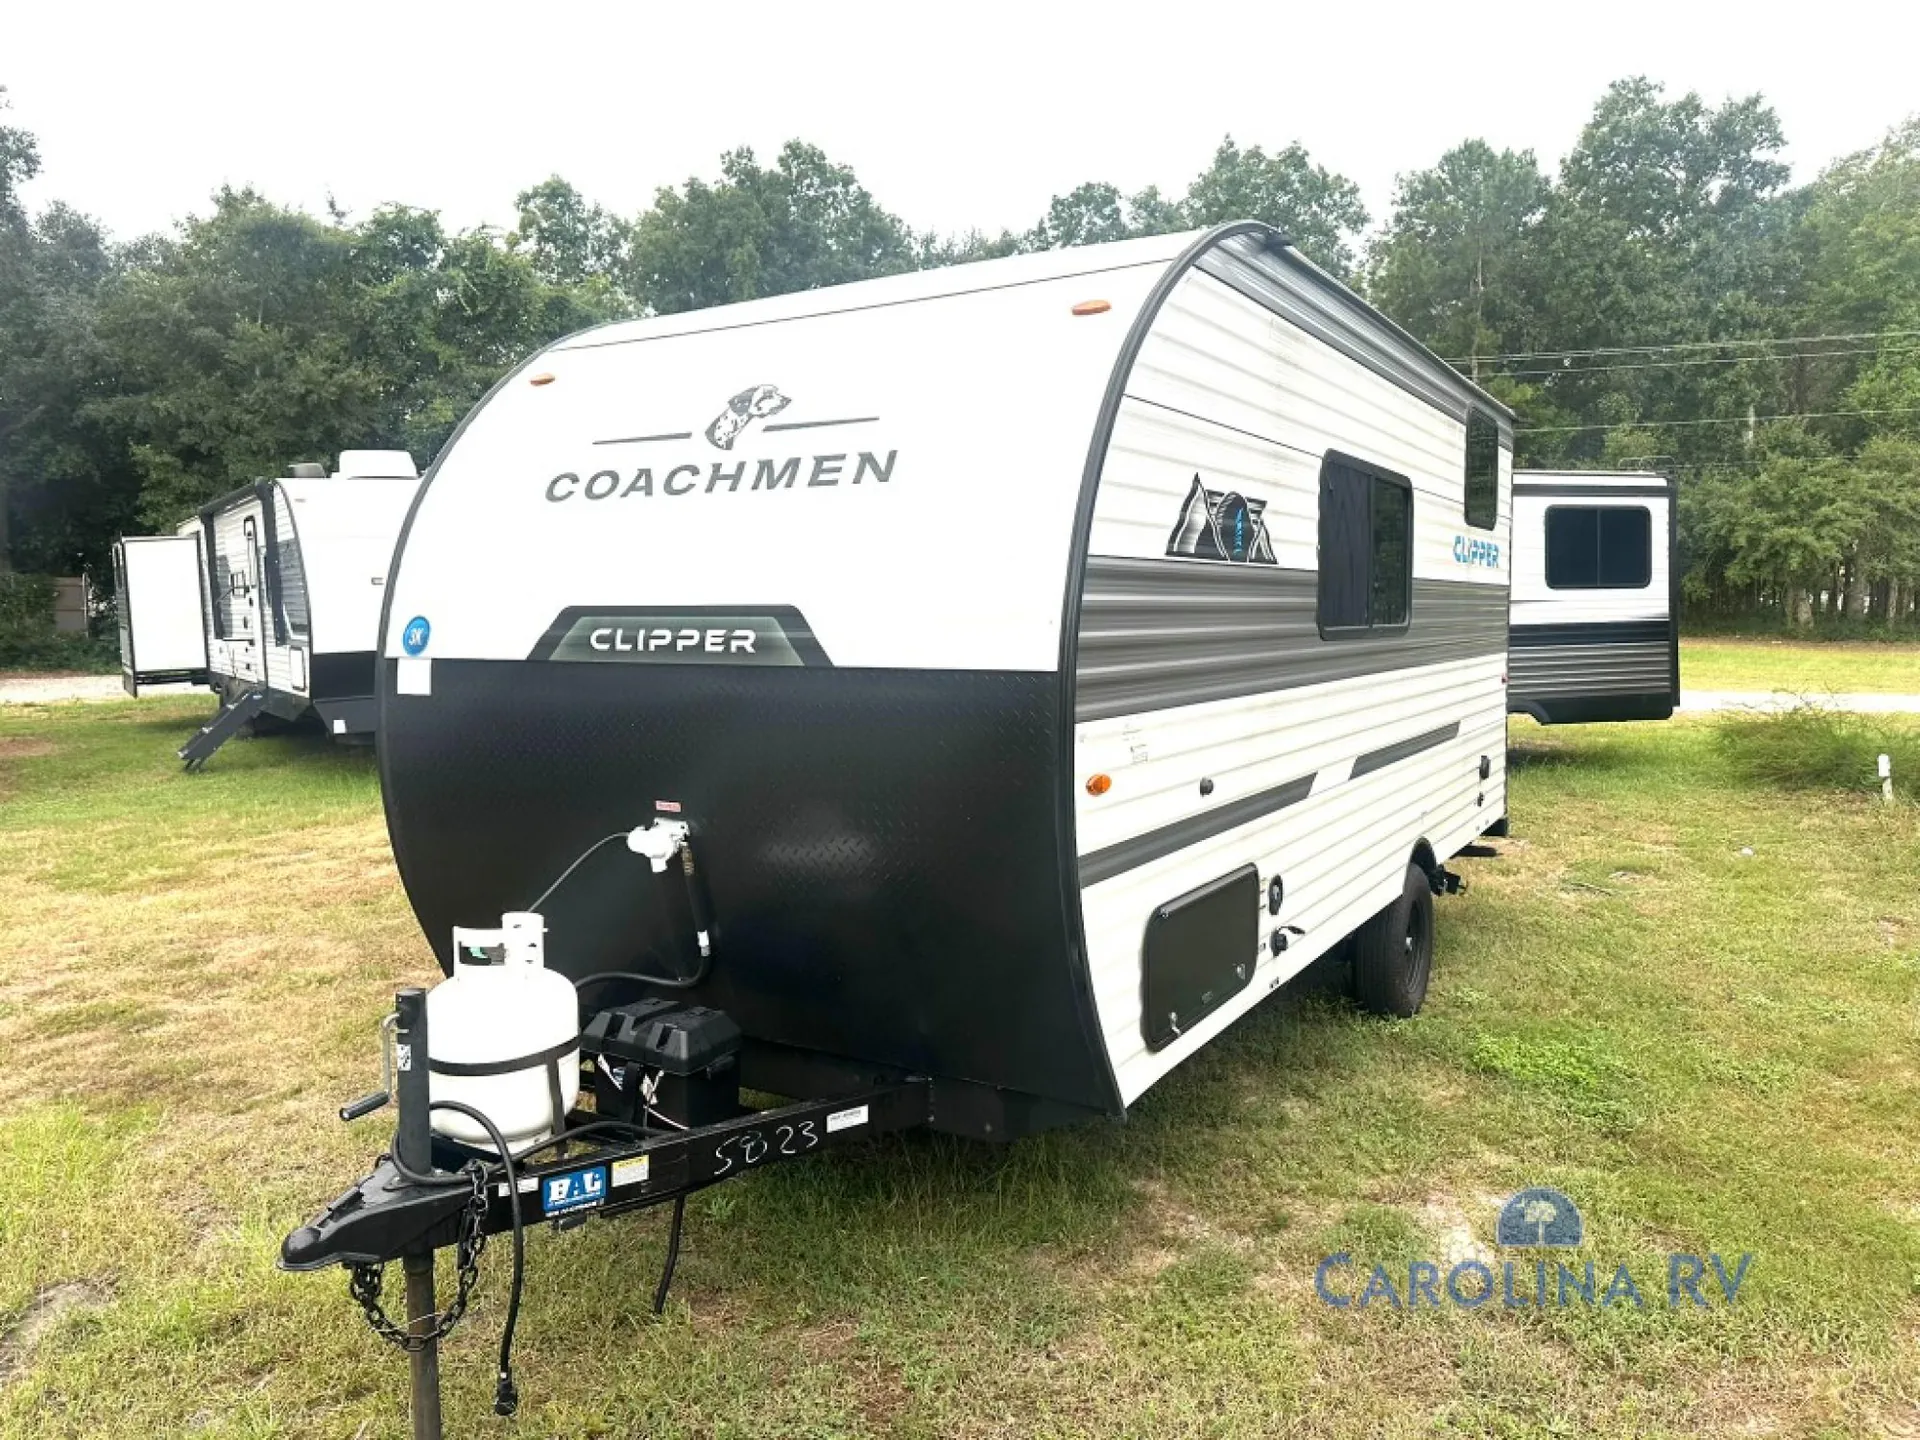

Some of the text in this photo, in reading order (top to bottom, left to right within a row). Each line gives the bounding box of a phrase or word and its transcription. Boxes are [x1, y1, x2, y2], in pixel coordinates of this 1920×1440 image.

[544, 449, 899, 503] COACHMEN
[1453, 535, 1499, 568] CLIPPER
[589, 628, 756, 653] CLIPPER
